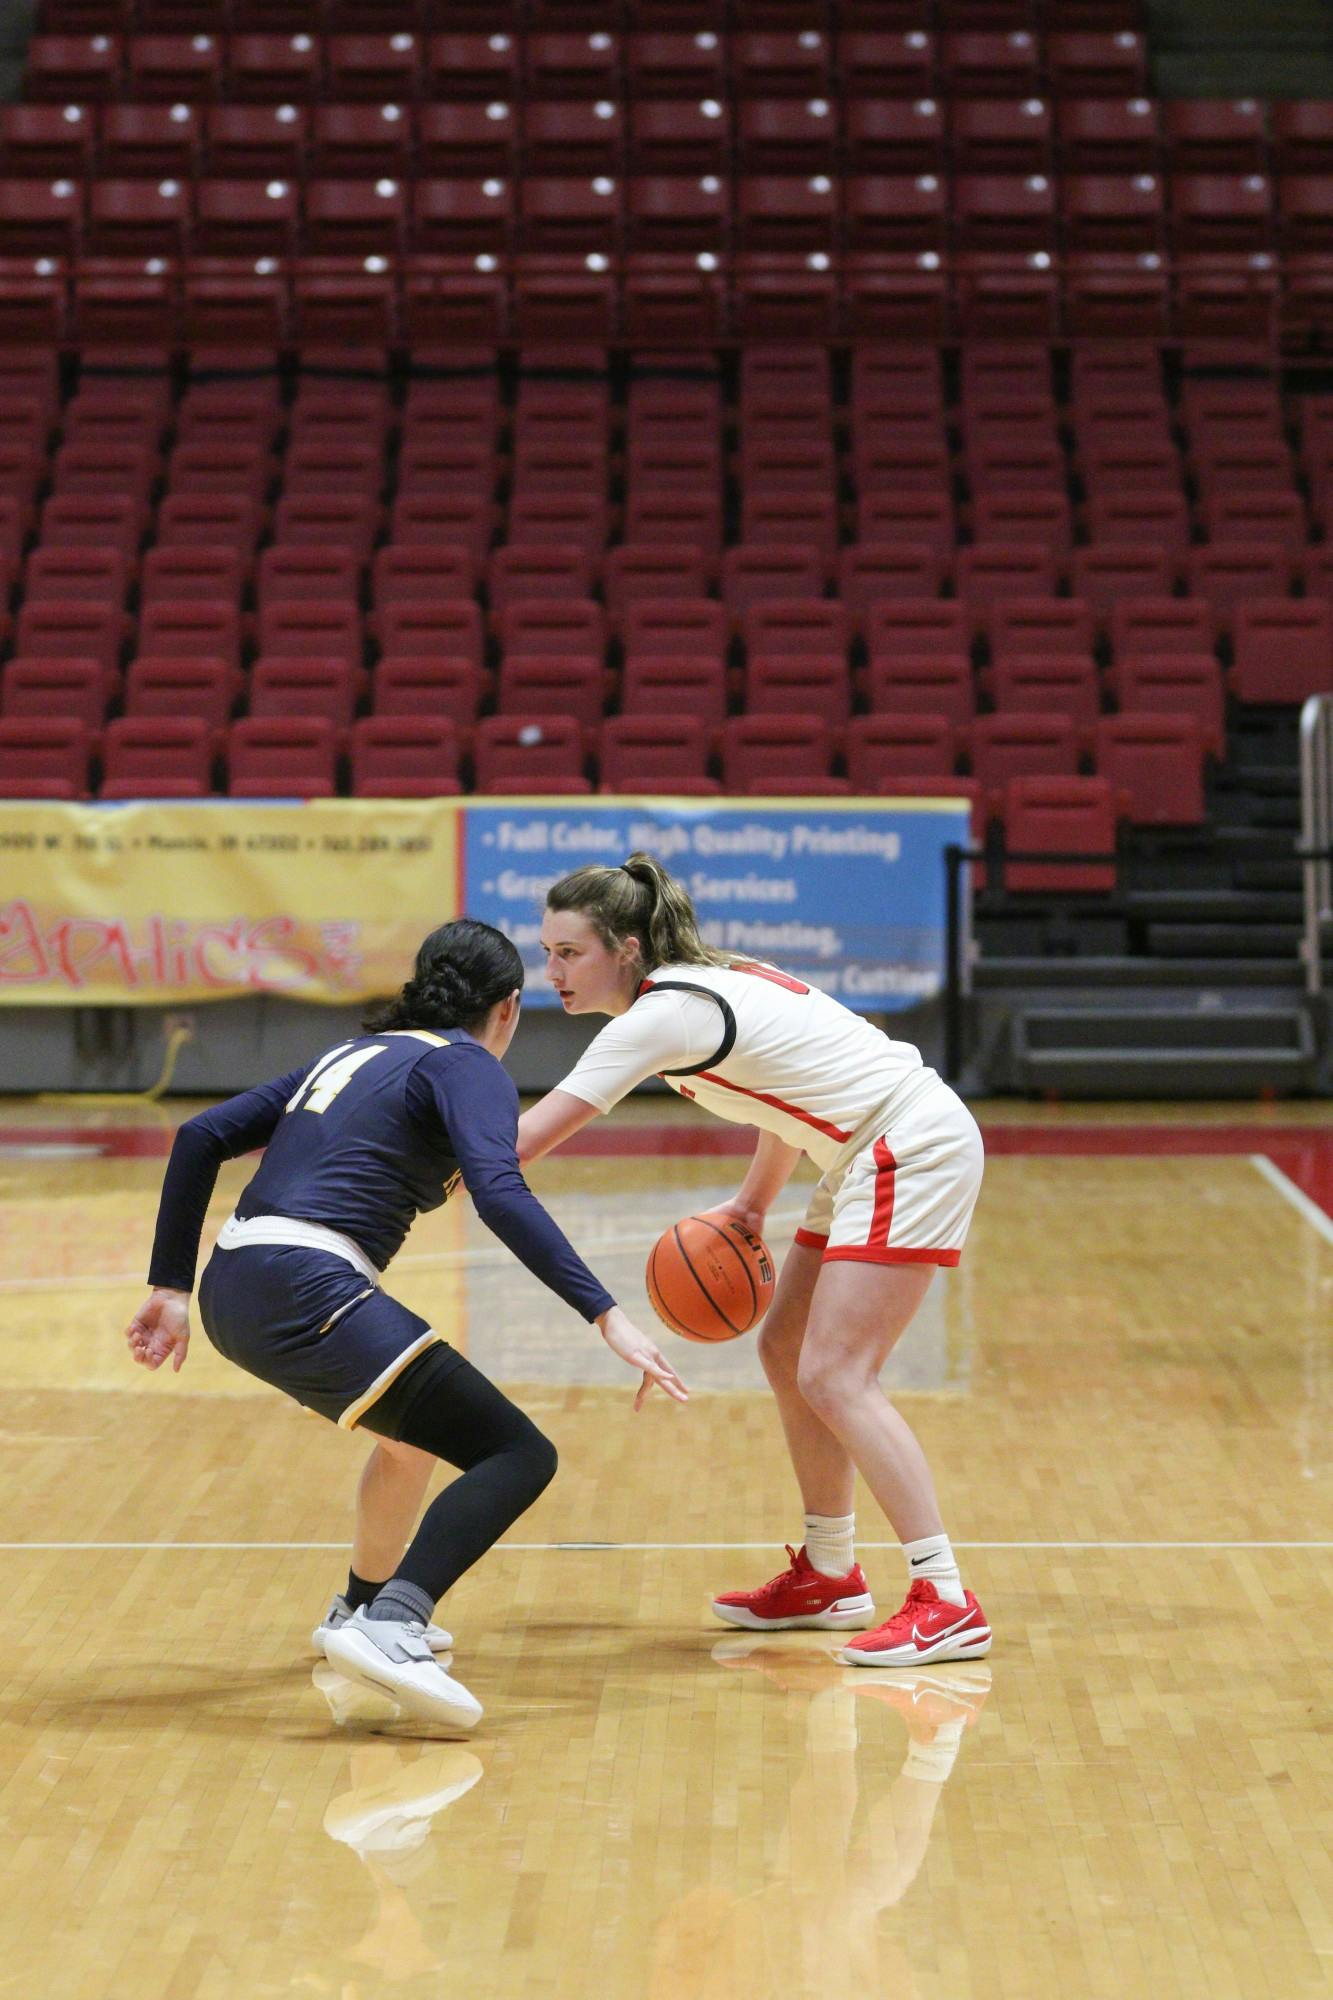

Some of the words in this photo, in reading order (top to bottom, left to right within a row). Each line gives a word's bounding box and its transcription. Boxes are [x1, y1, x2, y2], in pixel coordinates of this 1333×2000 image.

[498, 821, 548, 849] Full
[552, 822, 624, 853] Color,
[629, 823, 690, 859] High
[693, 824, 788, 861] Quality
[793, 825, 900, 862] Printing
[691, 873, 797, 900] Services
[285, 1043, 389, 1115] 14
